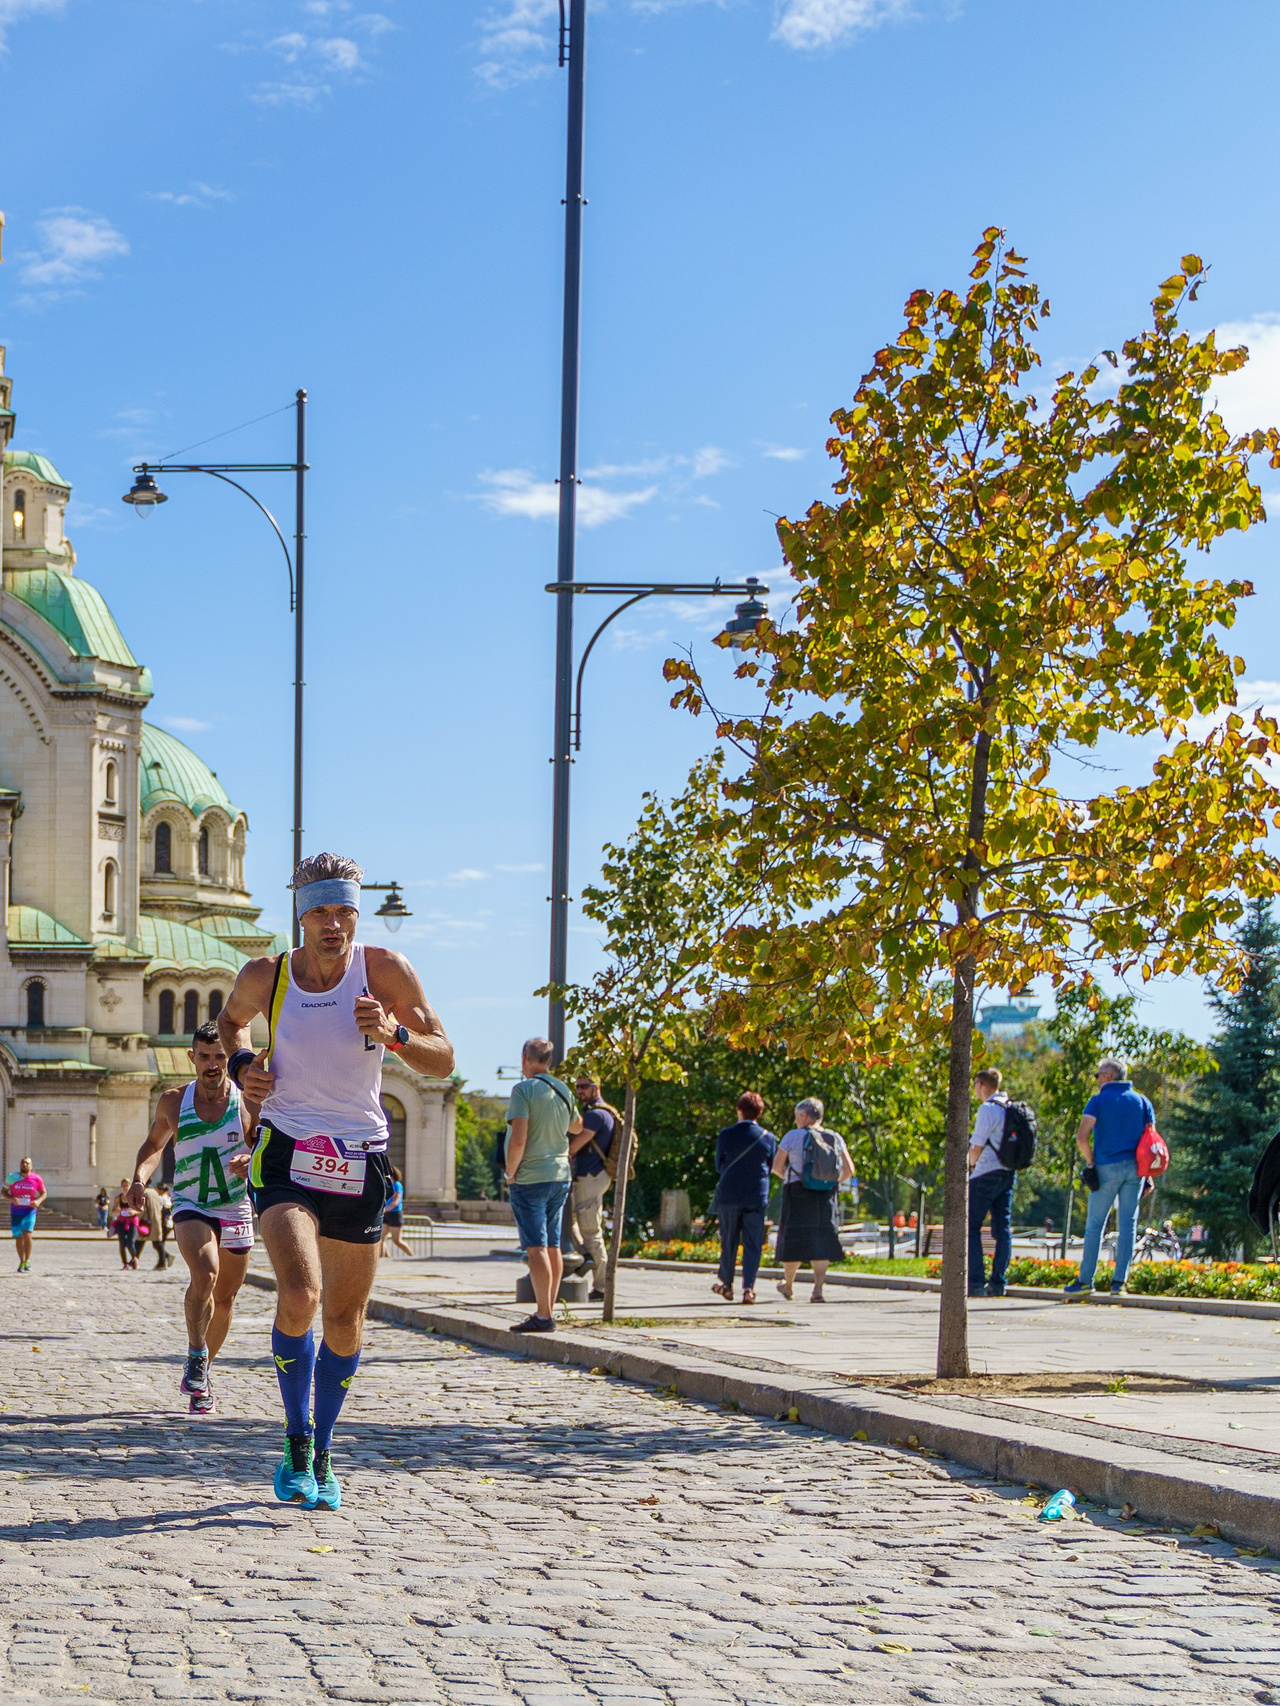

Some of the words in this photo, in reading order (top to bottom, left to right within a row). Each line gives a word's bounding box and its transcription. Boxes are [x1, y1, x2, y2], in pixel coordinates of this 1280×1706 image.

[301, 1000, 338, 1008] DIADORA
[312, 1156, 350, 1176] 394
[197, 1146, 232, 1204] A
[234, 1225, 250, 1236] 471
